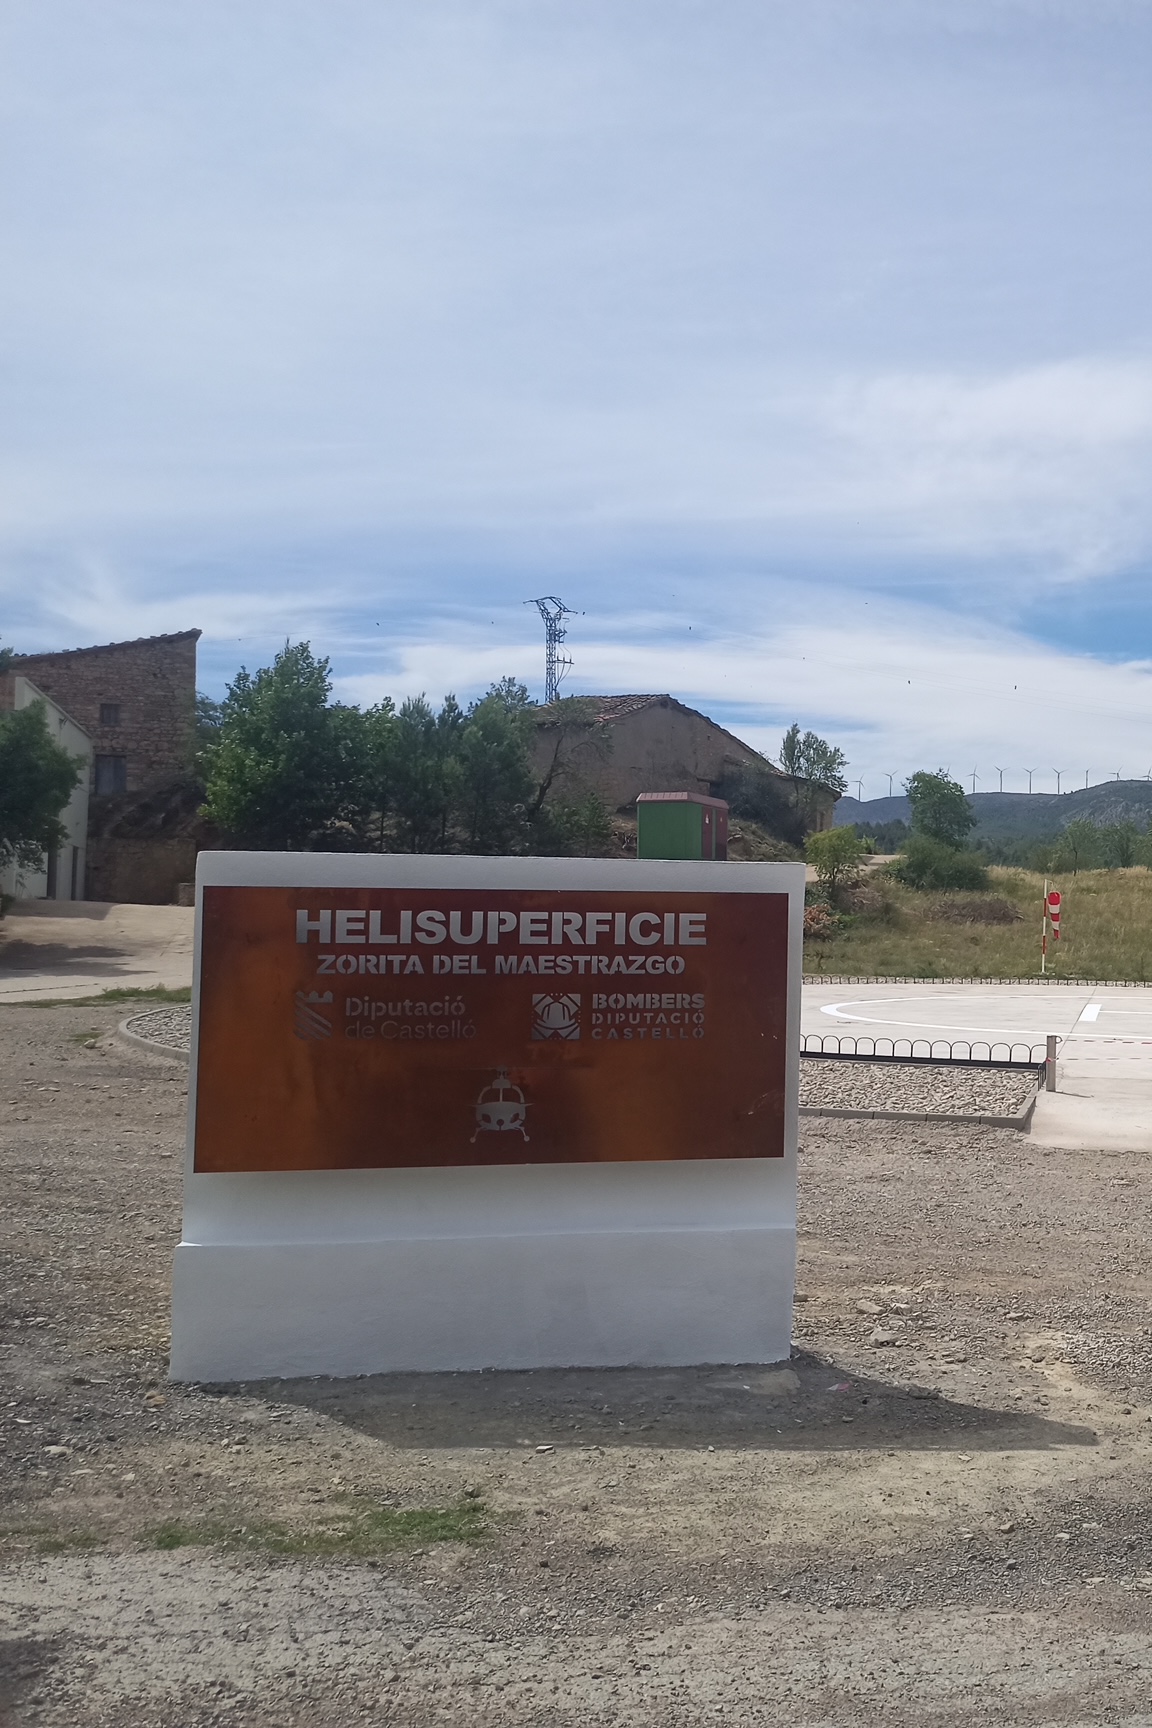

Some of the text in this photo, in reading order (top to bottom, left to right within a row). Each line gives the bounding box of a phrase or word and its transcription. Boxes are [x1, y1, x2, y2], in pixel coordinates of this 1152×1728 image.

[296, 909, 707, 945] HELISUPERFICIE
[316, 954, 685, 975] ZORITA DEL MAESTRAZGO
[345, 995, 466, 1020] Diputació
[592, 993, 705, 1009] BOMBERS
[591, 1010, 705, 1024] DIPUTACIÓ
[345, 1019, 477, 1040] de Castelló
[591, 1025, 705, 1039] CASTELLÓ
